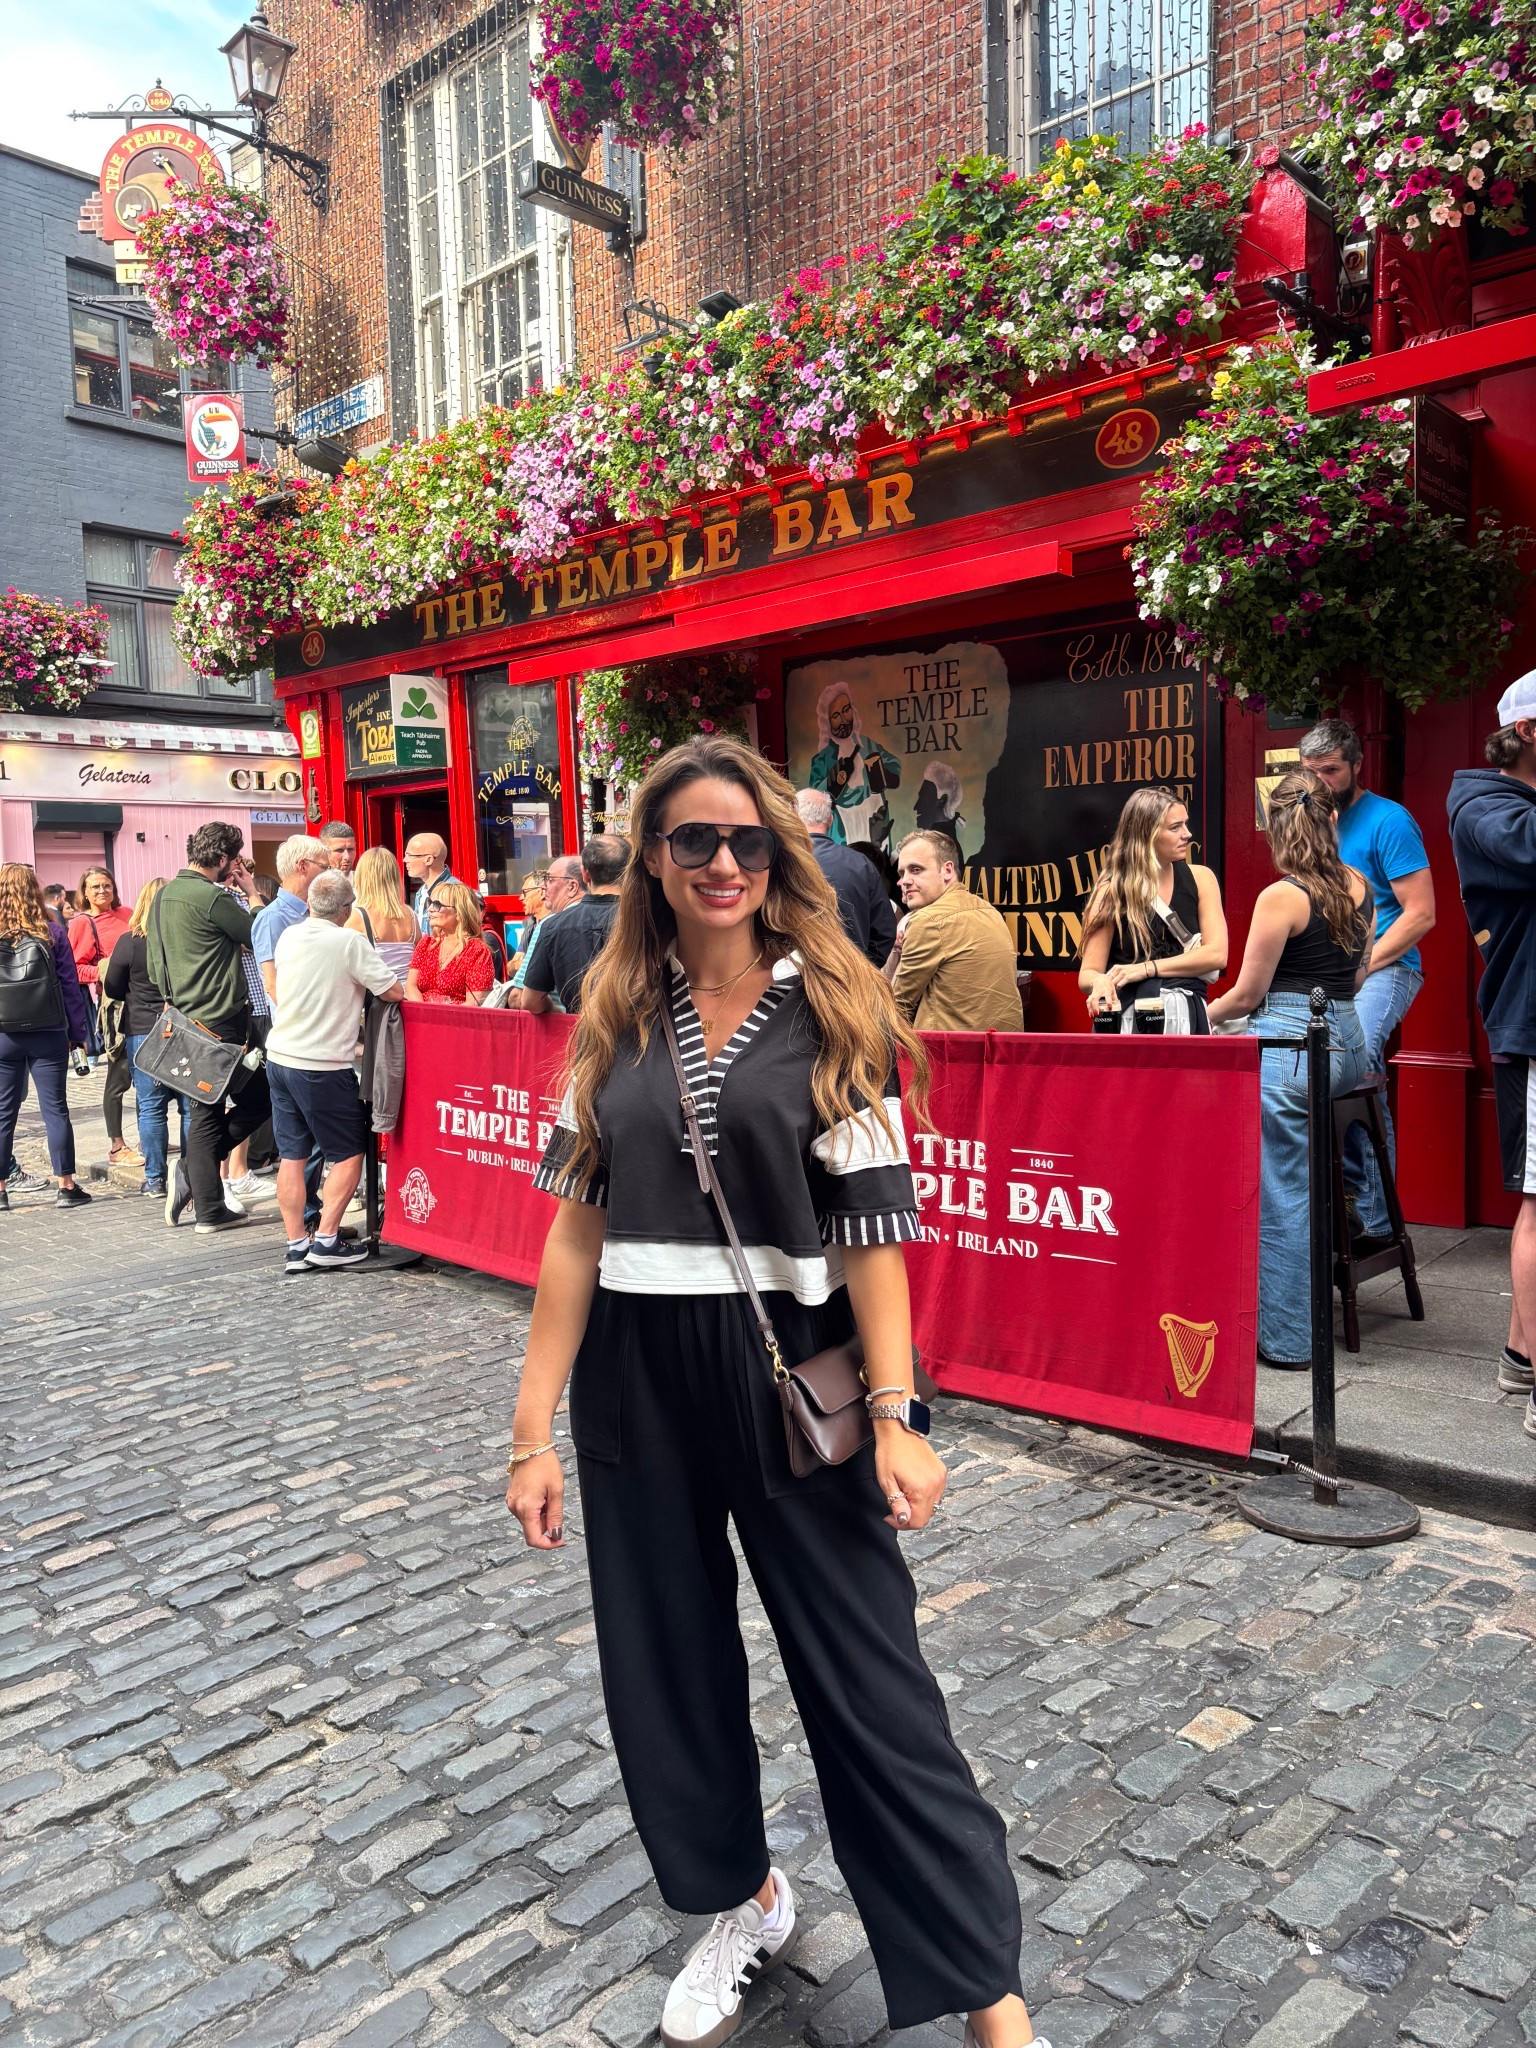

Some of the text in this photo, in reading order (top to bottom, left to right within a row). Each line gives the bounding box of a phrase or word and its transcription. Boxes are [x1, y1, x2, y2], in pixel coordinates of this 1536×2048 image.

[105, 153, 125, 194] THE
[121, 129, 197, 154] TEMPLE
[541, 167, 622, 217] GUINNESS
[1103, 420, 1144, 458] 48
[196, 460, 239, 469] GUINNESS
[203, 468, 218, 476] good
[414, 472, 916, 641] THE TEMPLE BAR
[306, 637, 320, 658] 48
[903, 659, 961, 694] THE
[345, 690, 380, 723] Importers
[366, 707, 374, 716] OF
[877, 686, 989, 728] TEMPLE
[1123, 683, 1194, 733] THE
[506, 738, 526, 752] THE
[904, 722, 963, 754] BAR
[78, 763, 152, 786] Gelateria
[370, 753, 395, 762] Always
[1043, 734, 1197, 789] EMPEROR
[477, 759, 562, 803] TEMPLE BAR
[491, 1084, 530, 1115] THE
[436, 1100, 531, 1149] TEMPLE
[467, 1148, 504, 1168] DUBLIN
[913, 1133, 1054, 1173] THE 1840
[1006, 1181, 1119, 1236] BAR
[956, 1230, 1039, 1259] IRELAND
